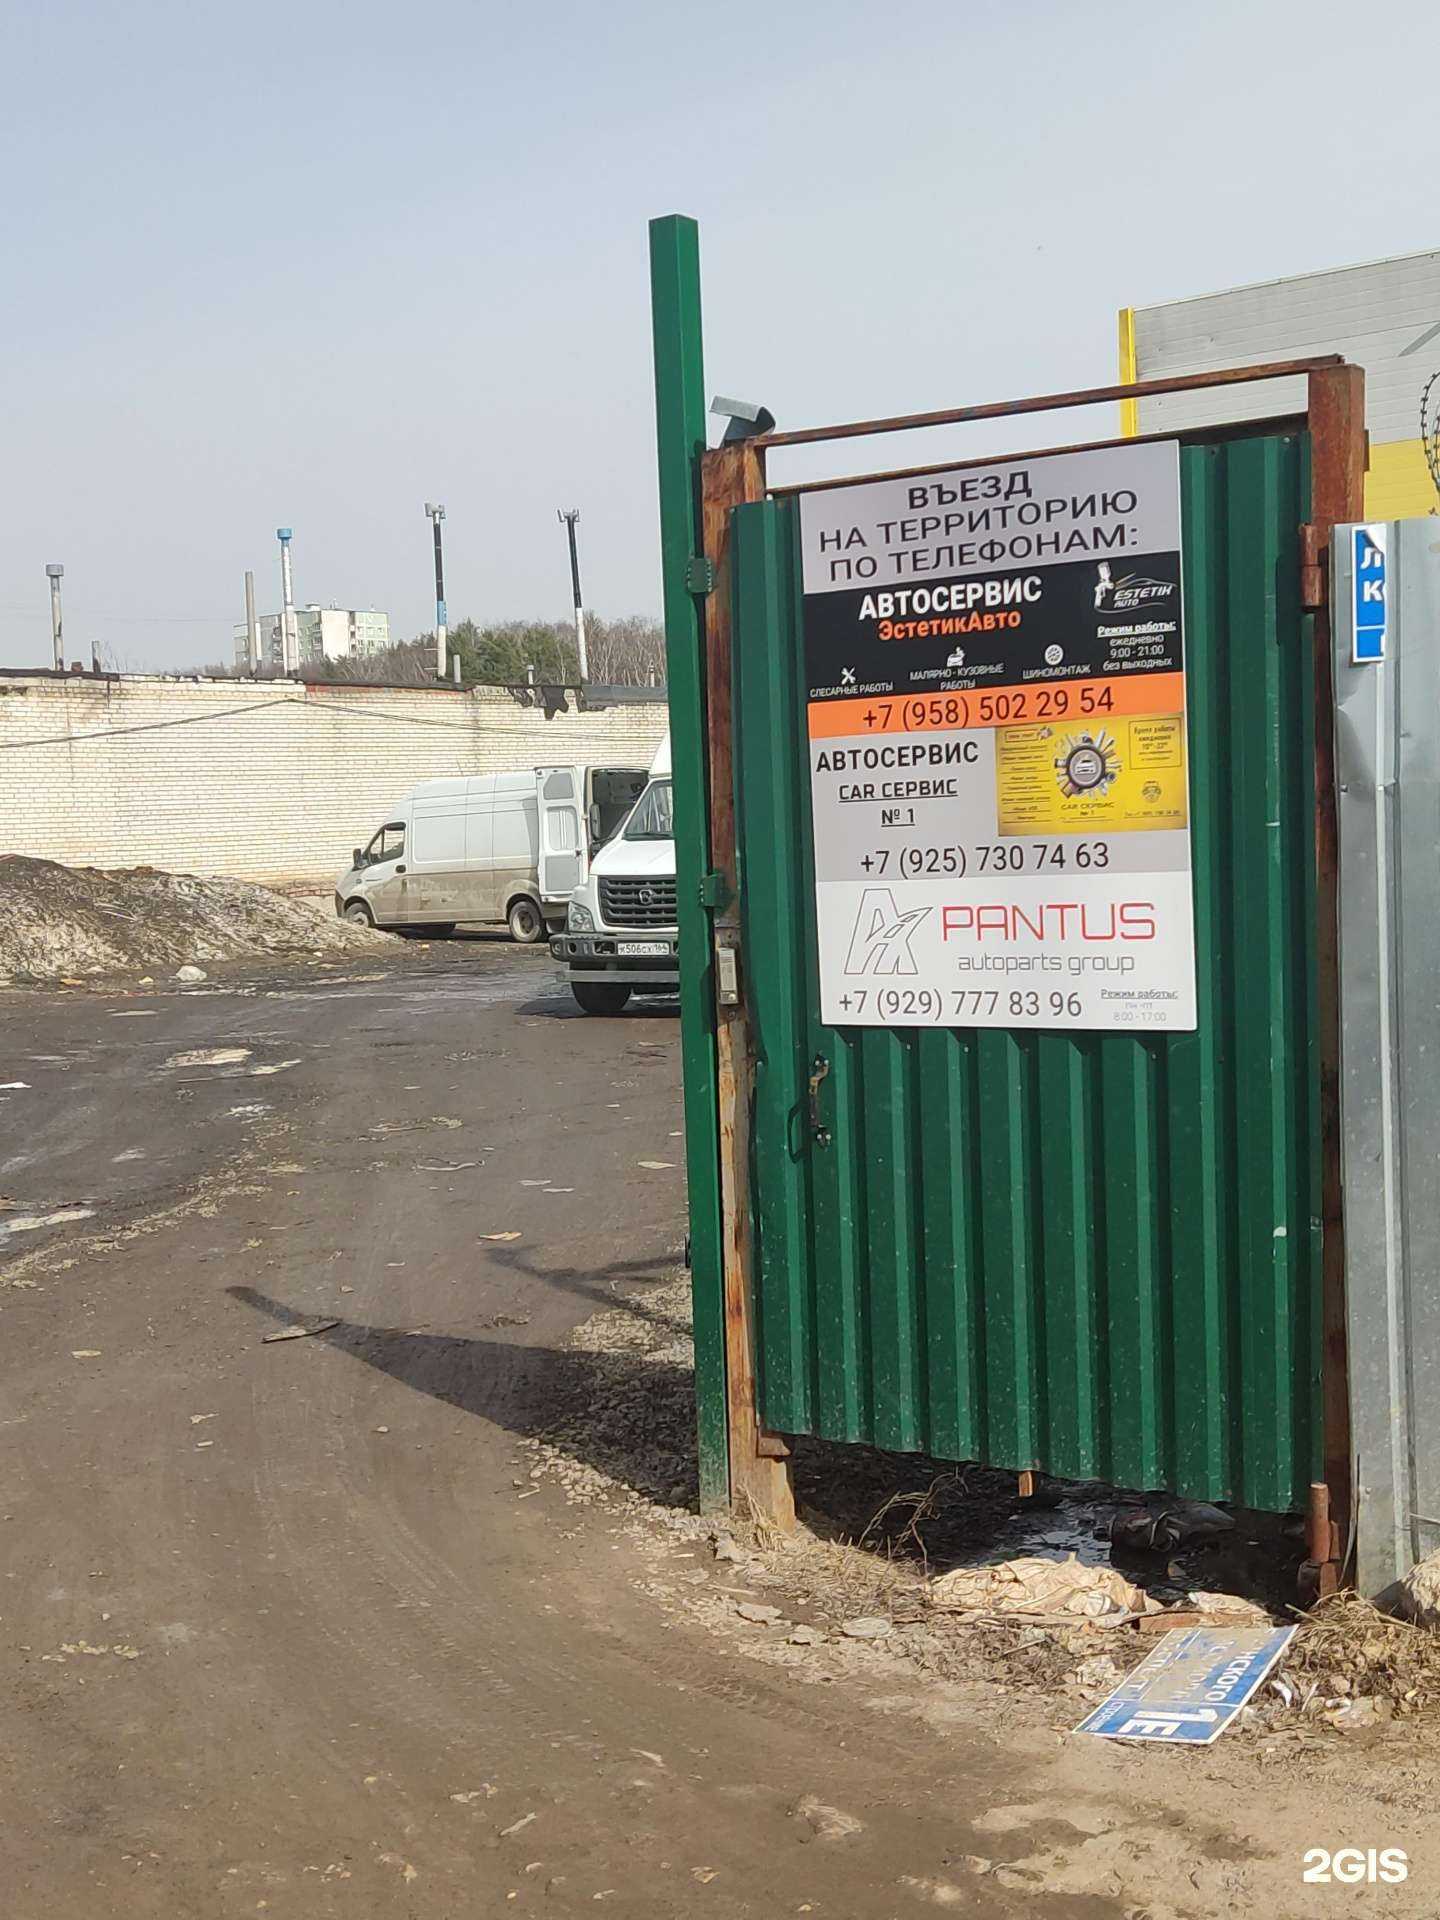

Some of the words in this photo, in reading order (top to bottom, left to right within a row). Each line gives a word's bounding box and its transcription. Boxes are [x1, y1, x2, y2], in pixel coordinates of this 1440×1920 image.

[908, 470, 1033, 510] ВЪЕЗД
[819, 526, 868, 553] НА
[877, 489, 1138, 545] ТЕРРИТОРИЮ
[830, 556, 877, 582] ПО
[887, 523, 1139, 576] ТЕЛЕФОНАМ:
[858, 575, 1042, 621] АВТОСЕРВИС
[878, 610, 1021, 641] ЭстетикАвто
[1097, 625, 1133, 638] Режим
[1134, 621, 1177, 635] работы:
[1109, 634, 1164, 647] ежедневно
[1110, 647, 1131, 658] 9:00
[1137, 645, 1164, 657] 21:00
[1022, 663, 1091, 680] ШИНОМОНТАЖ
[1103, 660, 1120, 671] без
[1121, 658, 1173, 669] выходных
[810, 684, 859, 698] СЛЕСАРНЫЕ
[859, 681, 894, 693] РАБОТЫ
[940, 679, 976, 690] РАБОТЫ
[862, 703, 893, 730] +7
[902, 695, 969, 731] (958)
[979, 693, 1028, 723] 502
[1036, 689, 1069, 717] 29
[1079, 685, 1114, 712] 54
[815, 741, 979, 774] АВТОСЕРВИС
[838, 782, 876, 802] CAR
[881, 778, 959, 799] СЕРВИС
[880, 807, 902, 826] №
[906, 806, 916, 825] 1
[860, 850, 890, 875] +7
[899, 845, 967, 880] (925)
[975, 844, 1025, 871] 730
[1032, 843, 1067, 870] 74
[1075, 841, 1109, 868] 63
[941, 901, 1157, 942] PANTUS
[958, 952, 1063, 976] autoparts
[1067, 954, 1136, 976] group
[838, 990, 867, 1015] +7
[876, 988, 943, 1021] (929)
[951, 990, 1000, 1016] 777
[1008, 991, 1041, 1017] 83
[1048, 992, 1083, 1018] 96
[1100, 988, 1135, 1000] Режим
